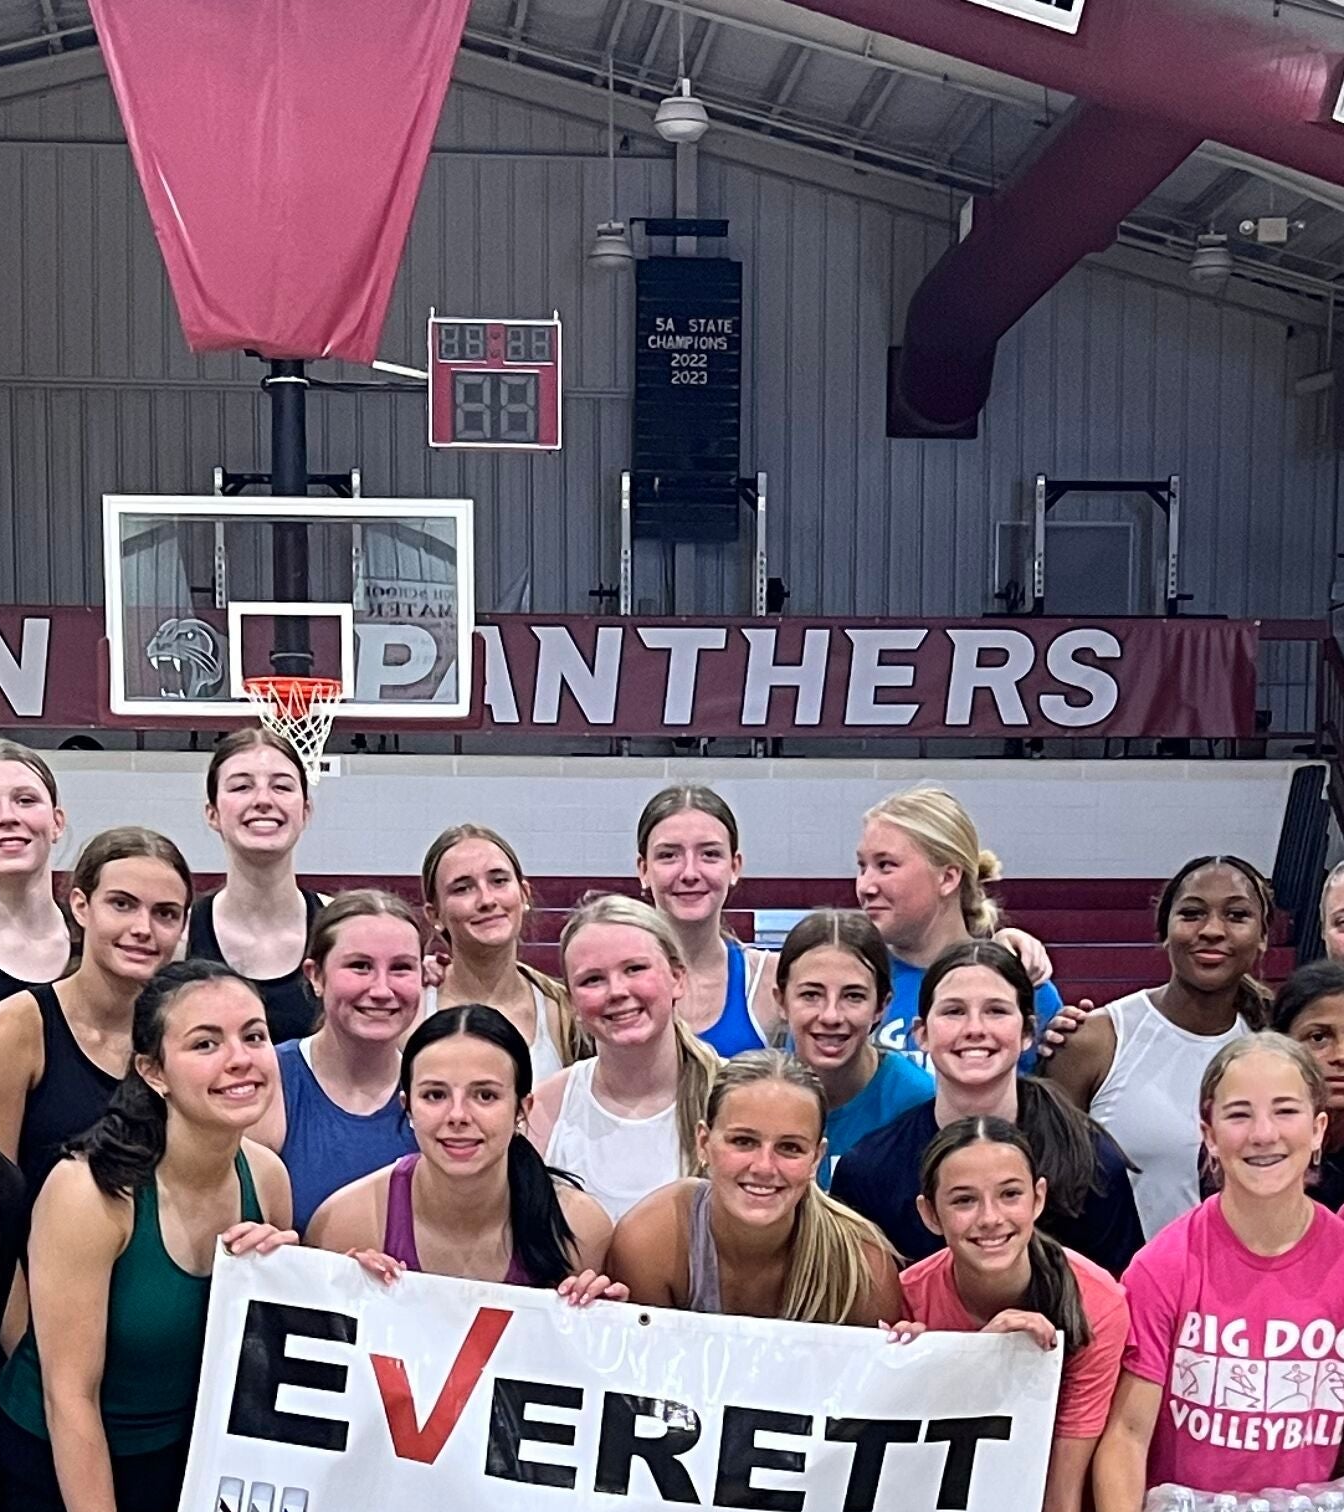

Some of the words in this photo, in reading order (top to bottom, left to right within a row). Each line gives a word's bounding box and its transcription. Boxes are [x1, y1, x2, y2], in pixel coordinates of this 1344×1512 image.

[655, 317, 675, 332] 5A
[688, 319, 733, 333] STATE
[647, 335, 728, 350] CHAMPIONS
[671, 353, 708, 367] 2022
[671, 370, 708, 385] 2023
[354, 623, 1122, 728] PANTHERS
[1178, 1311, 1249, 1358] BIG
[1169, 1399, 1344, 1450] VOLLEYBALL
